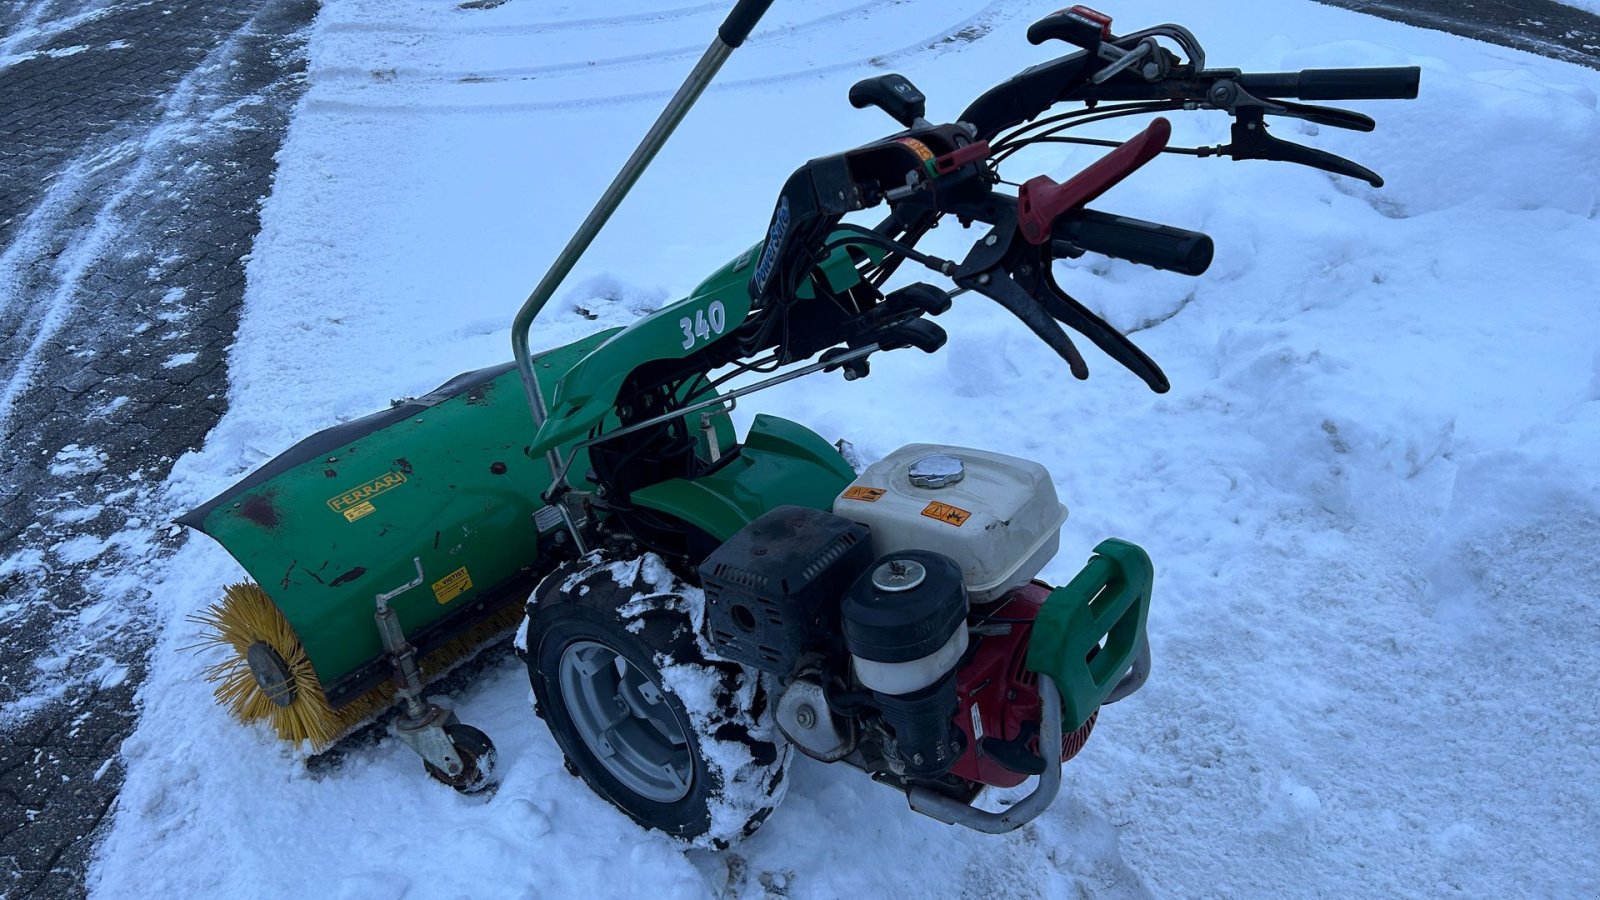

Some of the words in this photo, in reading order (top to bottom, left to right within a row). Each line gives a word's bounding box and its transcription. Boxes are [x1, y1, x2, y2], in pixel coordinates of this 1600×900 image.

[754, 206, 790, 289] PowerSafe
[680, 300, 725, 350] 340
[332, 473, 403, 510] FERRARI
